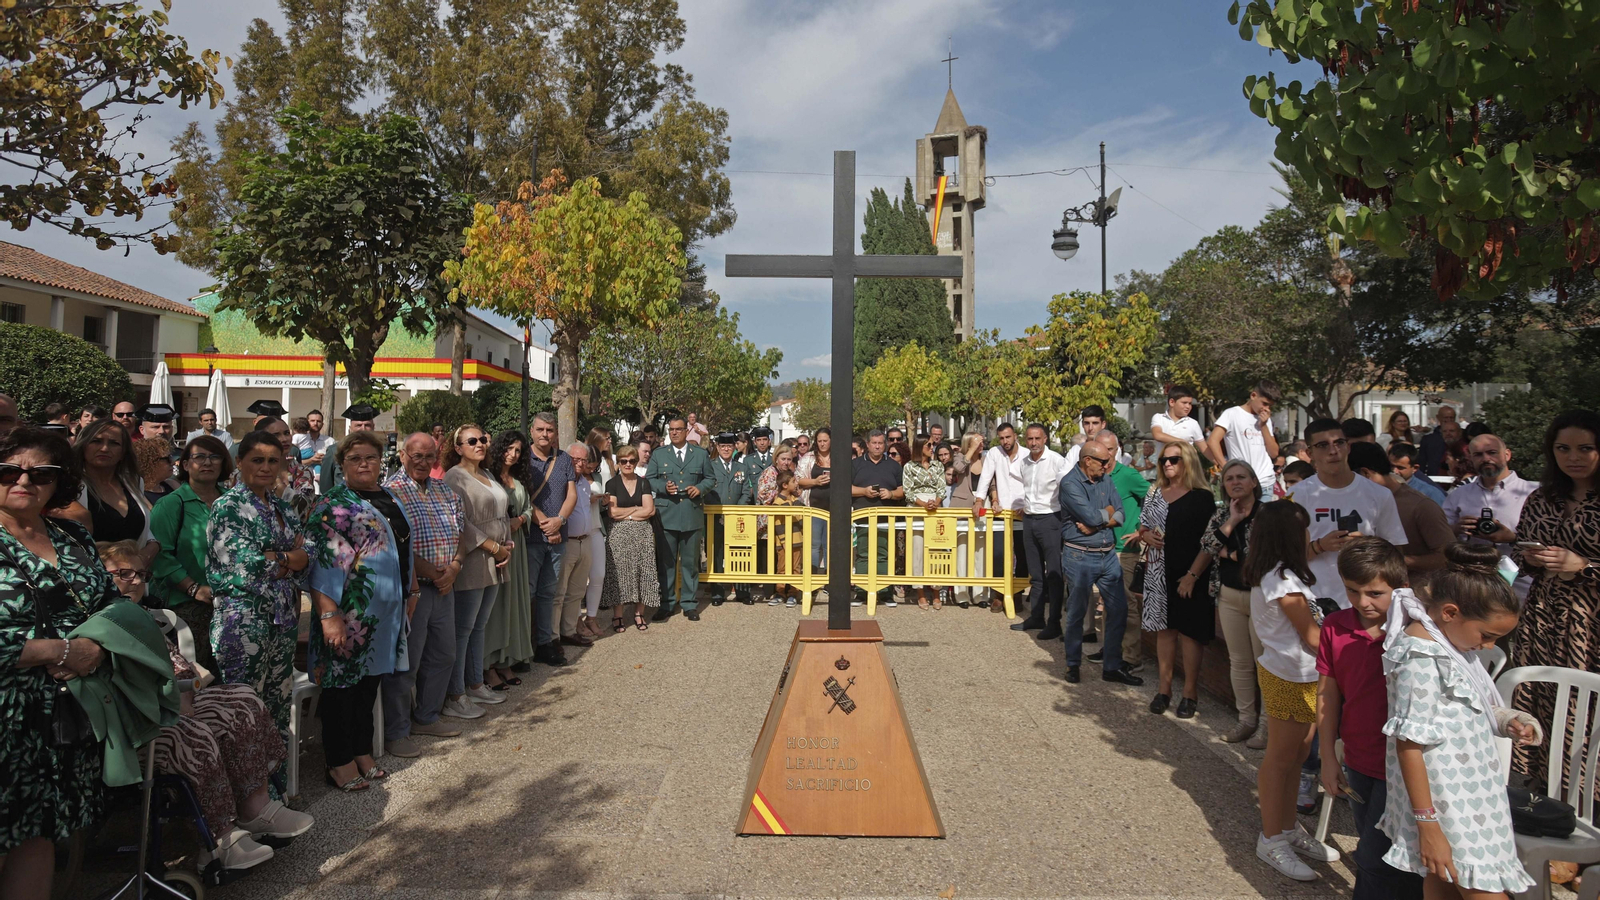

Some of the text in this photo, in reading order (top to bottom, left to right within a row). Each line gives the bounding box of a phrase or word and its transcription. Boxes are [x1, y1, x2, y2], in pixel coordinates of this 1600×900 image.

[787, 736, 840, 749] HONOR
[786, 757, 858, 770] LEALTAD
[786, 778, 872, 791] SACRIFICIO
